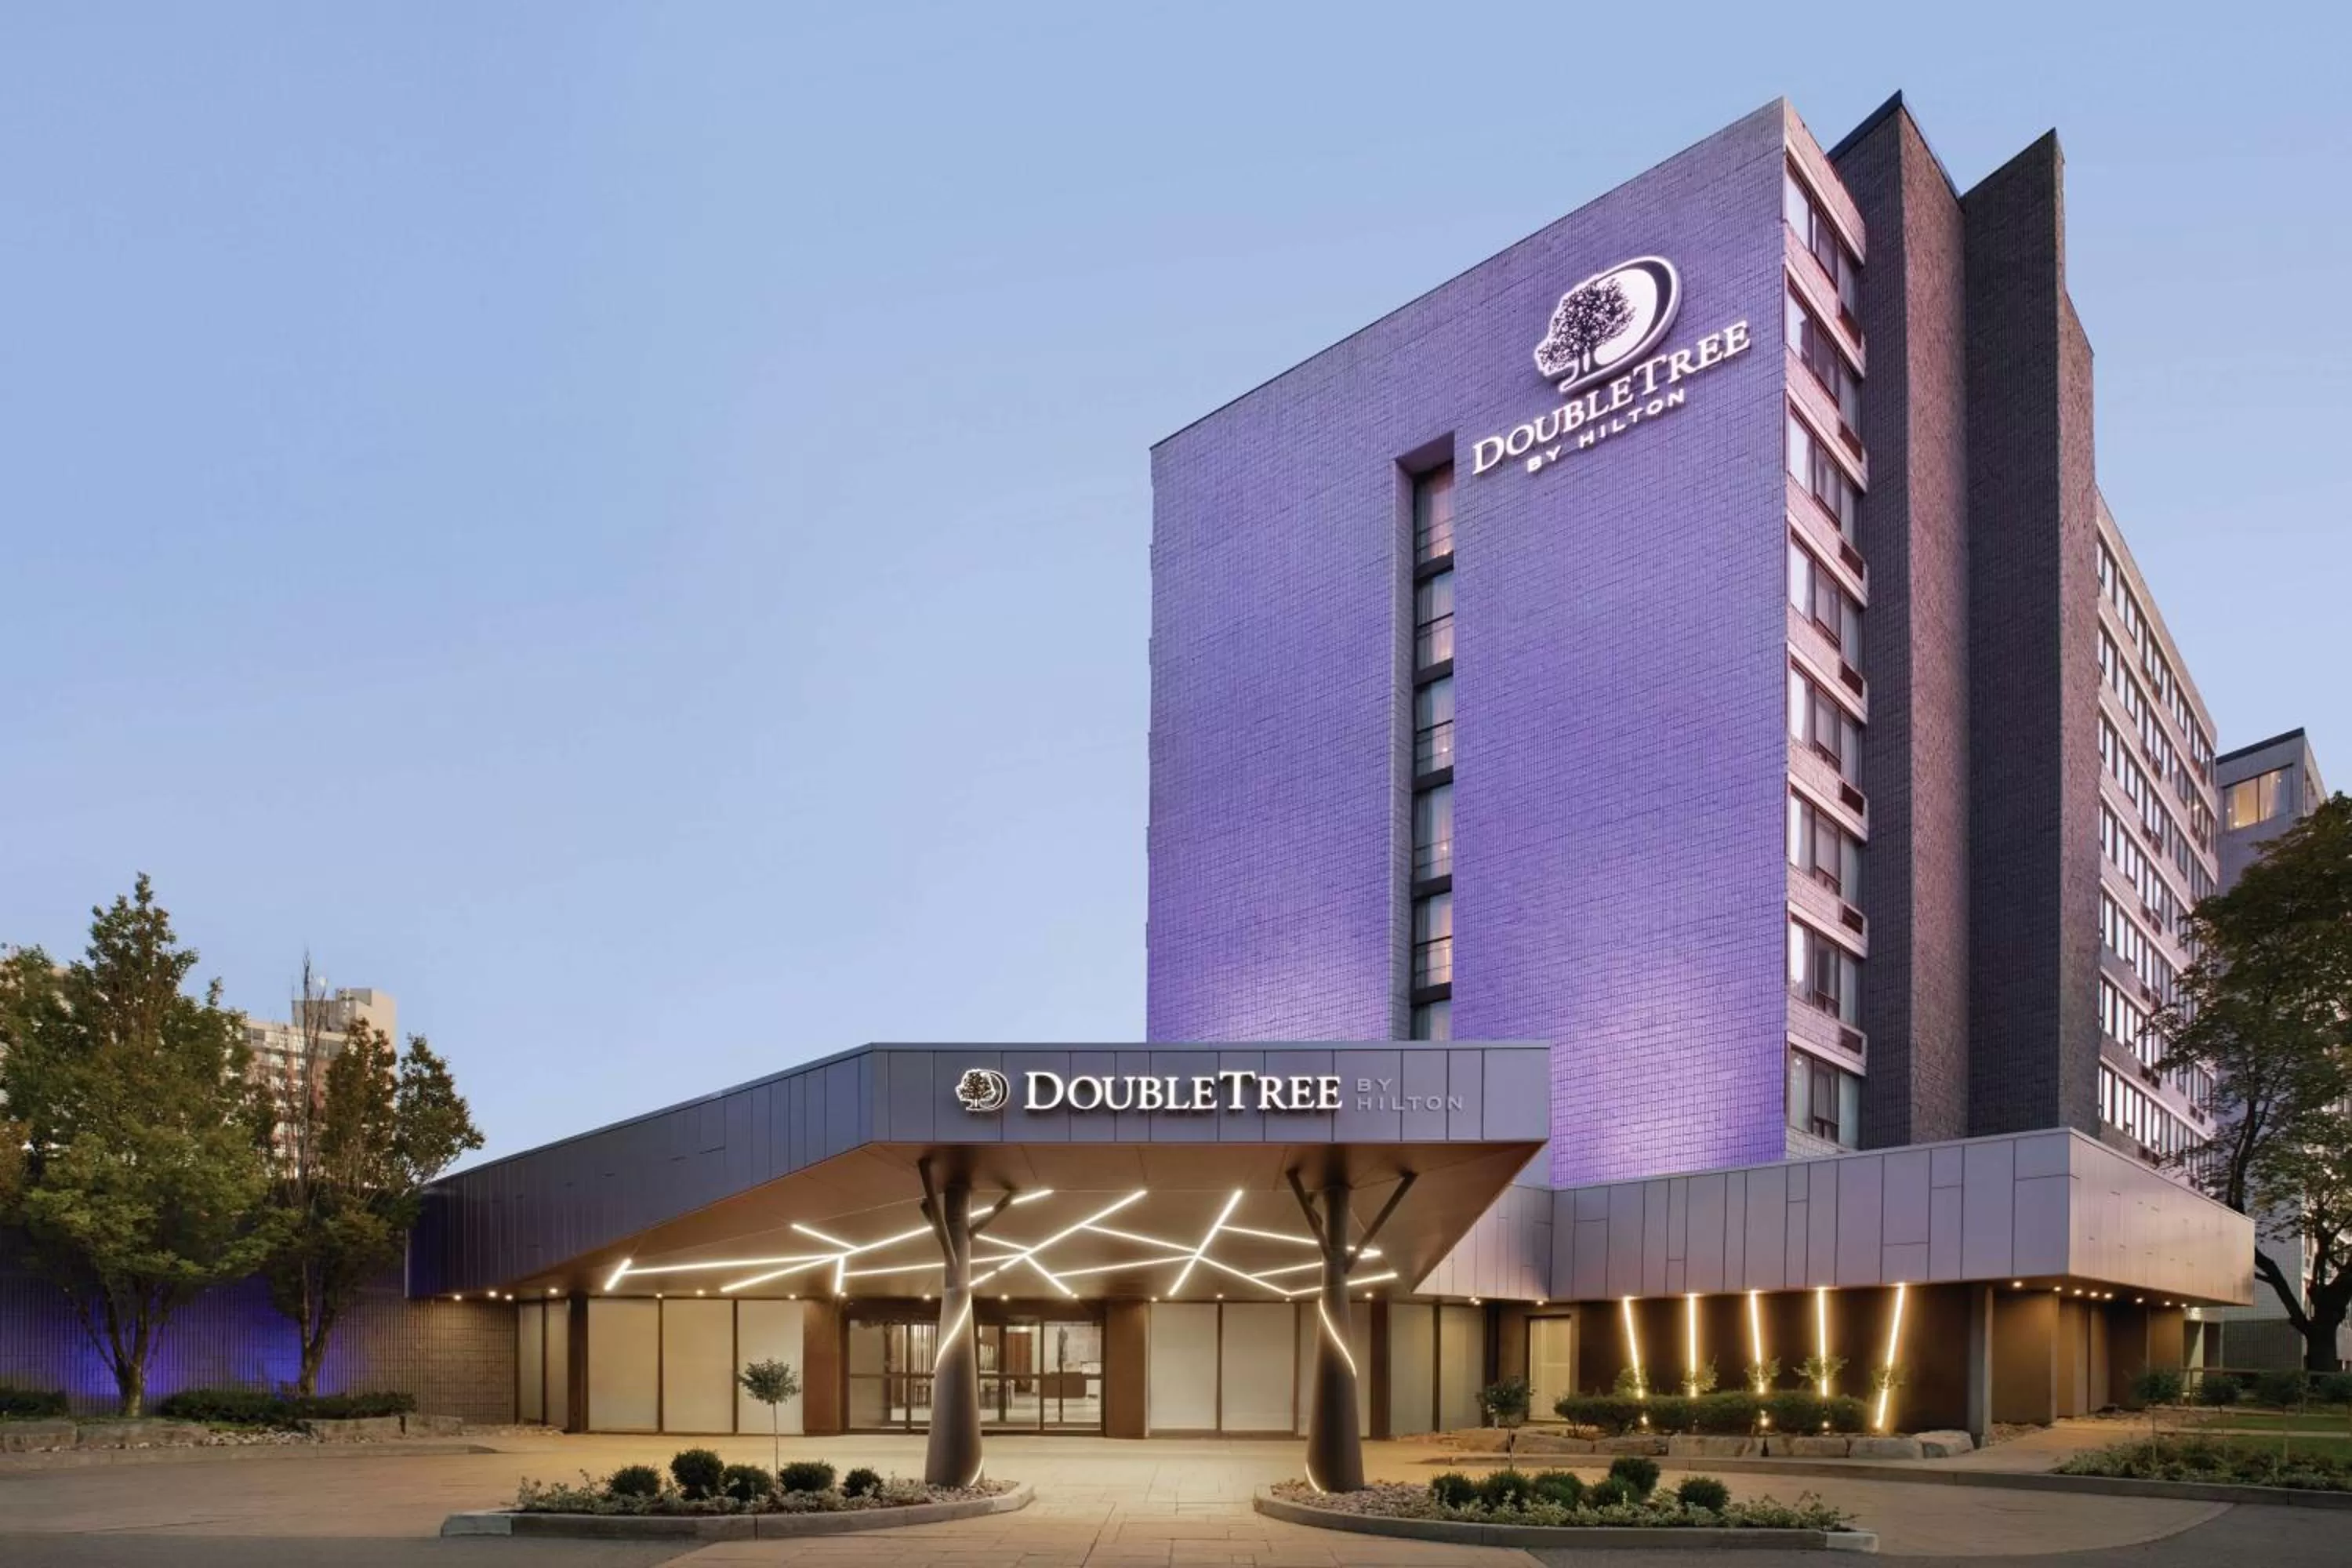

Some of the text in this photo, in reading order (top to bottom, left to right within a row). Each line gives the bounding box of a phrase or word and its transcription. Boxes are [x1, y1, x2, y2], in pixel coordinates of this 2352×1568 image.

[1526, 389, 1685, 473] BY HILTON
[1356, 1078, 1393, 1092] BY
[1356, 1095, 1464, 1111] HILTON
